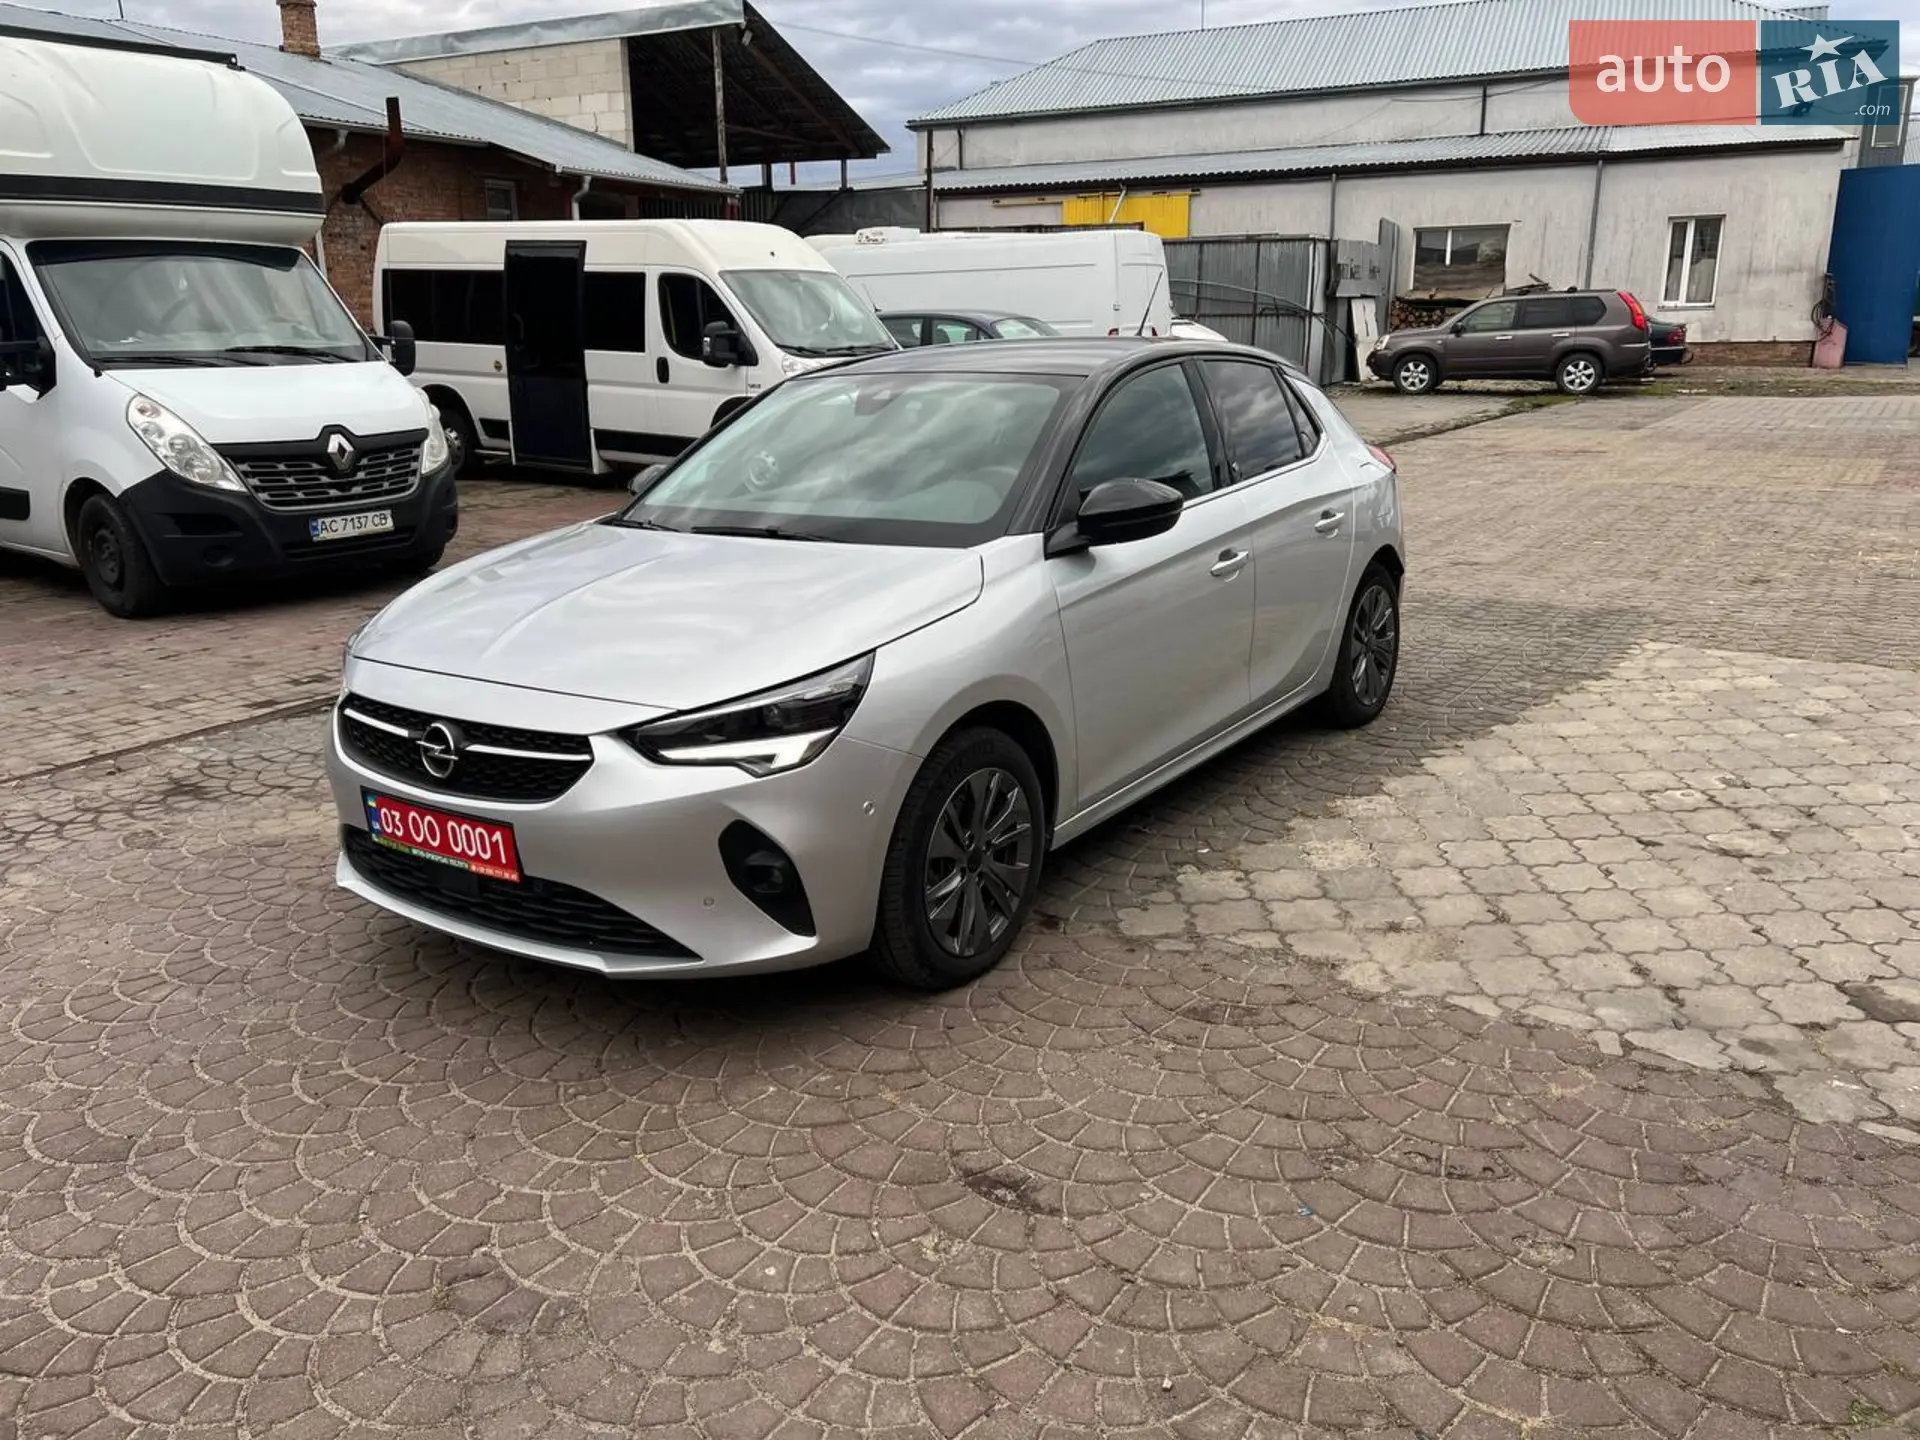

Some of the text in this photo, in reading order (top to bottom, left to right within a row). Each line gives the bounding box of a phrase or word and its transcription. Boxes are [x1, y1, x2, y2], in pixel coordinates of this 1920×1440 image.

[321, 519, 338, 533] AC
[341, 516, 368, 531] 7137
[372, 513, 387, 527] CB
[380, 807, 404, 837] 03
[447, 821, 507, 865] 0001
